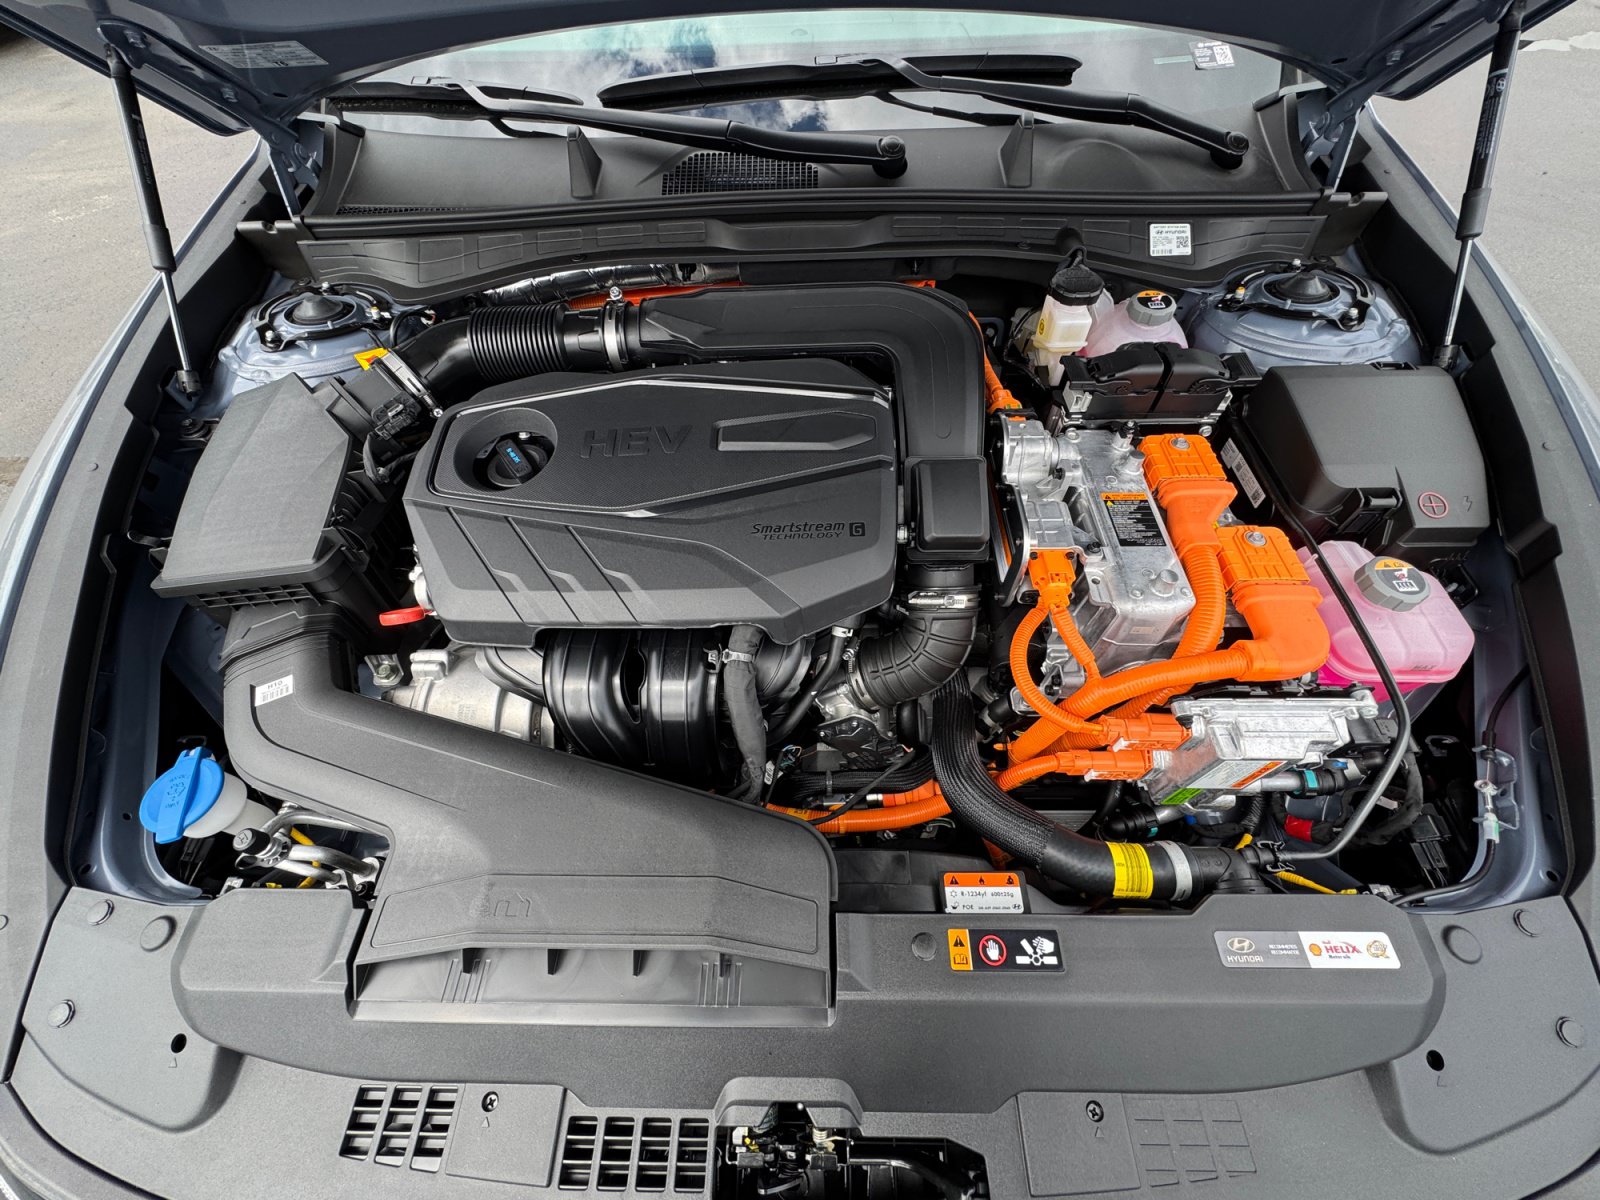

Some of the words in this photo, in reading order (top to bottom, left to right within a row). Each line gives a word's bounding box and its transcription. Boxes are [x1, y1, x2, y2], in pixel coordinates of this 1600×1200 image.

[580, 425, 693, 458] HEV
[750, 521, 845, 535] Smartstream
[763, 531, 843, 541] TECHNOLOGY
[1324, 945, 1360, 954] HELIX
[1226, 955, 1264, 963] HYUNDAI
